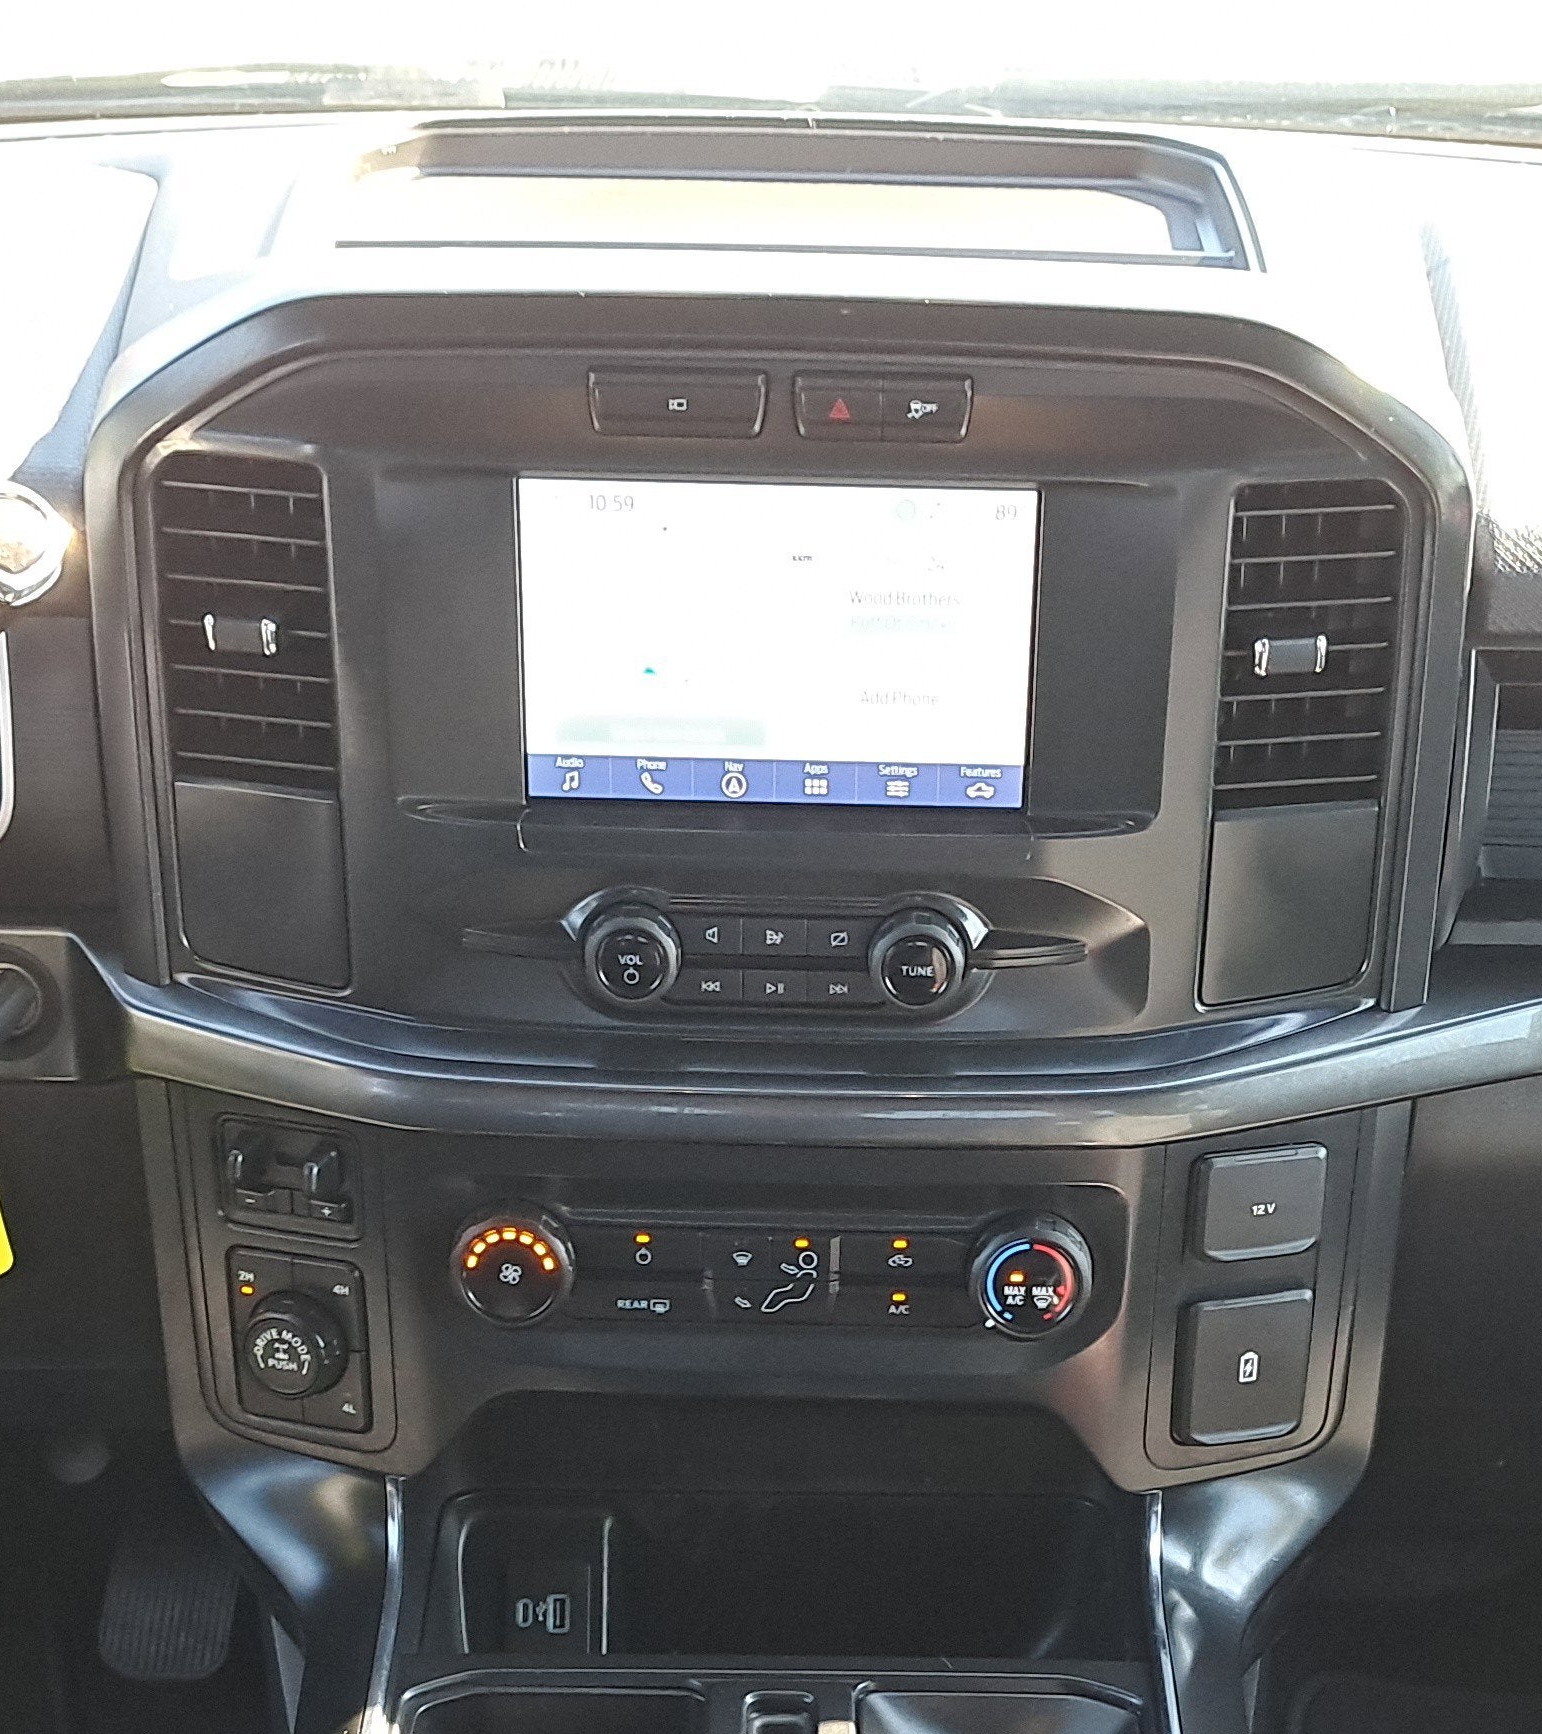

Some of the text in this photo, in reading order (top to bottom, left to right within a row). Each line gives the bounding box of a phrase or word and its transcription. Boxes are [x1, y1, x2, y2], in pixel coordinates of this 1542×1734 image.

[555, 757, 585, 769] Audio
[636, 759, 667, 772] Phone
[803, 763, 829, 775] Apps
[878, 764, 918, 778] Settings
[960, 767, 1002, 779] Features
[617, 954, 644, 966] VOL
[901, 965, 935, 977] TUNE
[1251, 1202, 1276, 1216] 12 V
[238, 1270, 255, 1283] 2H
[332, 1284, 350, 1296] 4H
[1003, 1285, 1027, 1296] MAX
[1031, 1285, 1055, 1296] MAX
[616, 1299, 649, 1310] REAR
[1006, 1295, 1025, 1306] A/C
[888, 1304, 910, 1315] A/C
[253, 1327, 312, 1361] DRIVE MODE
[267, 1357, 299, 1372] PUSH
[341, 1402, 357, 1415] 4L
